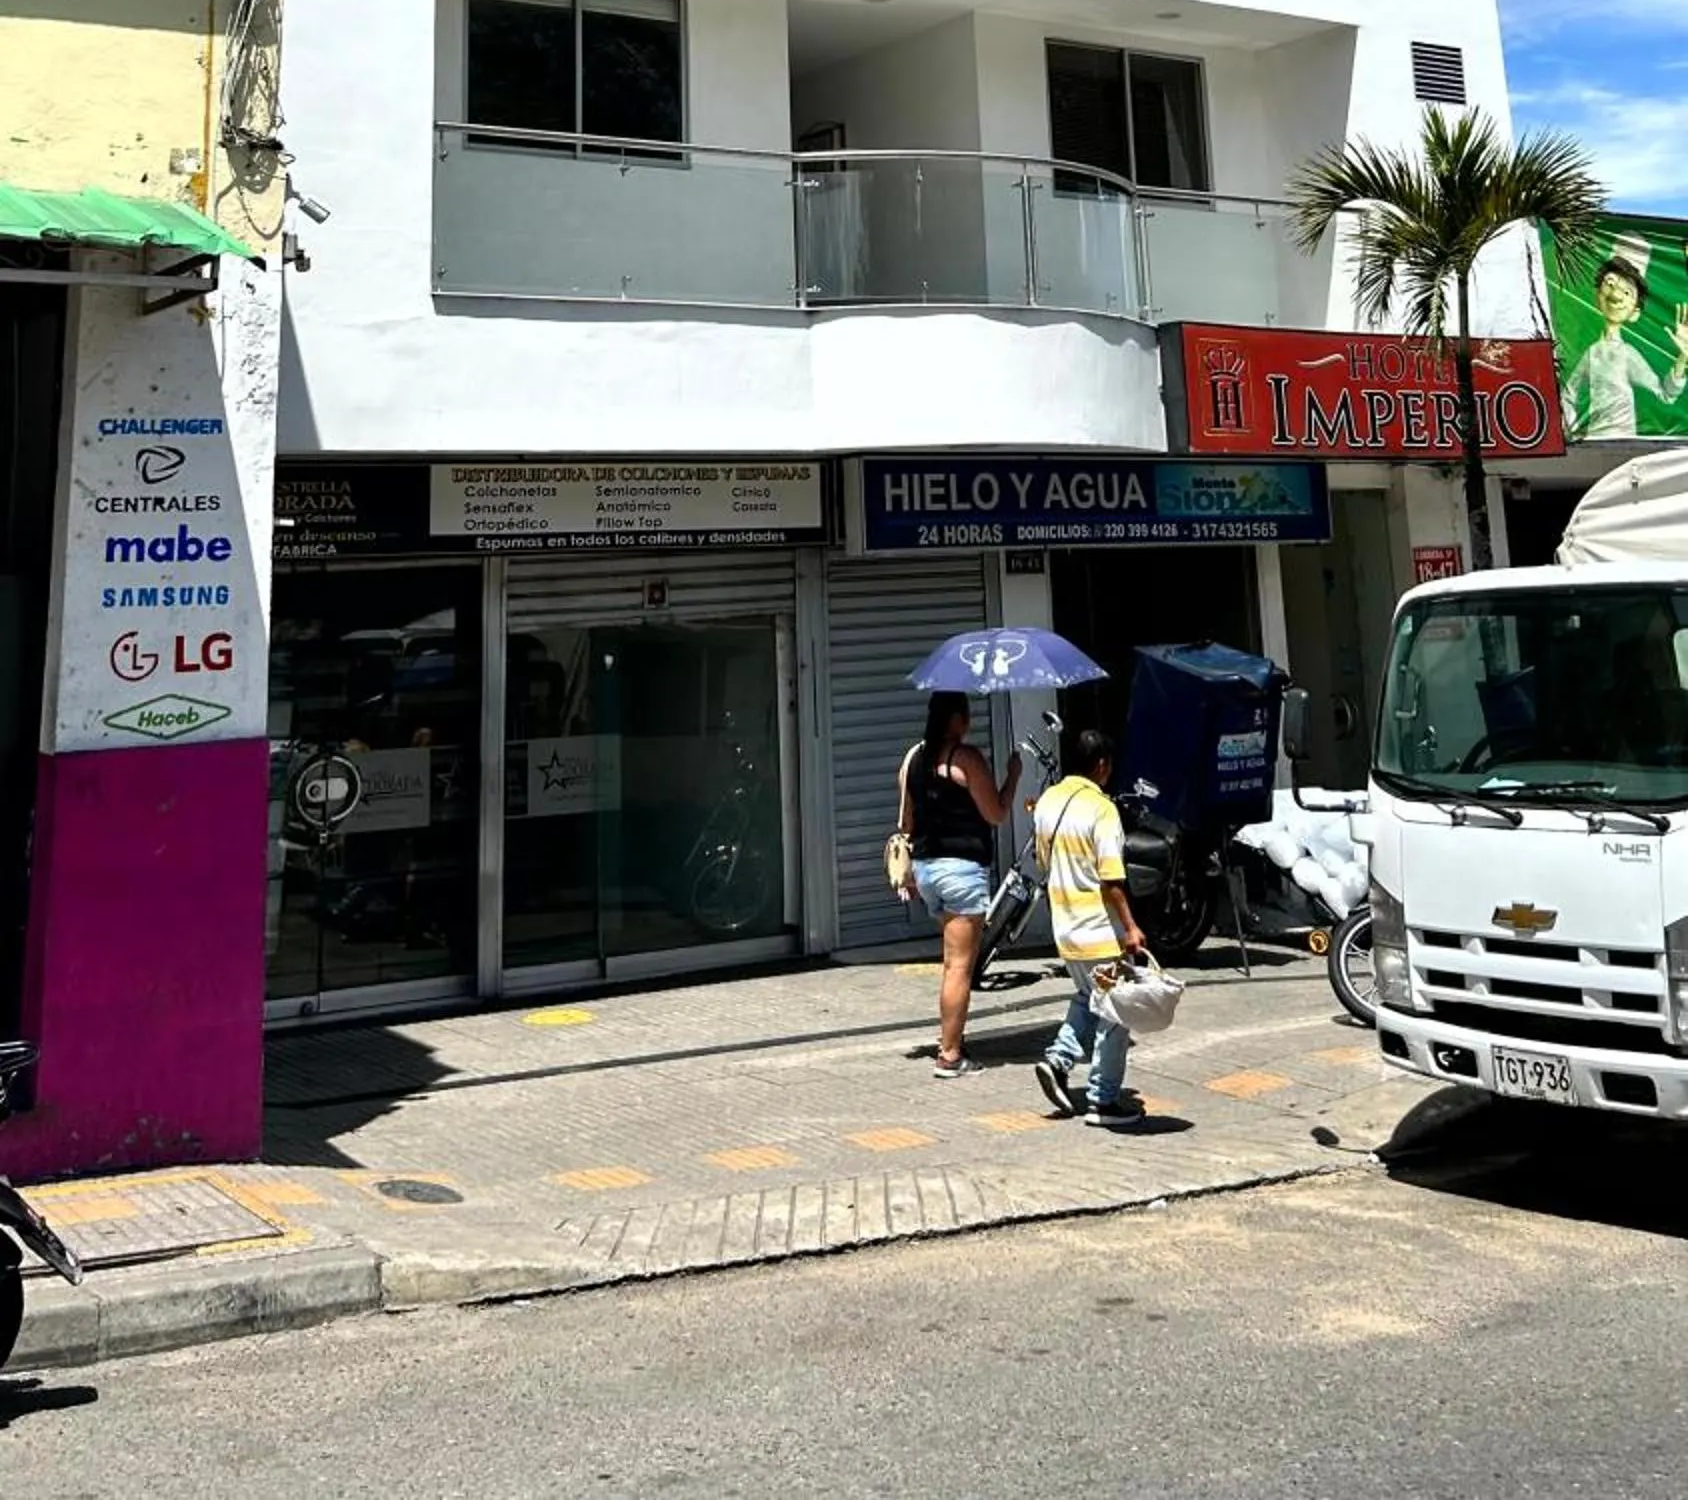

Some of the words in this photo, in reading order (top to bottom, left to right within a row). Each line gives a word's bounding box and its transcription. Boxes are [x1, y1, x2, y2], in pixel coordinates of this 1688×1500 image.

[1346, 343, 1464, 385] HOTE
[1266, 373, 1549, 449] IMPERIO
[99, 418, 223, 436] CHALLENGER
[452, 468, 589, 482] DISTRIBUIDORA
[592, 468, 616, 482] DE
[620, 467, 718, 481] COLCHONES
[721, 467, 732, 481] Y
[736, 466, 810, 480] ESPUMAS
[277, 480, 353, 494] STRELLA
[464, 485, 557, 497] Colchonetas
[884, 473, 1000, 512] HIELO
[1008, 472, 1034, 510] Y
[1043, 471, 1148, 510] AGUA
[95, 496, 221, 513] CENTRALES
[464, 518, 549, 532] Ortopédico
[596, 517, 635, 529] Pillow
[917, 525, 939, 545] 24
[943, 524, 1004, 544] HORAS
[1191, 521, 1279, 538] 3174321565
[105, 524, 232, 563] mabe
[476, 537, 543, 551] Espumas
[547, 538, 567, 548] en
[571, 534, 611, 546] todos
[615, 533, 636, 545] los
[639, 532, 694, 545] calibres
[695, 534, 704, 547] y
[708, 530, 785, 544] densidades
[102, 585, 230, 608] SAMSUNG
[174, 633, 234, 673] LG
[137, 707, 201, 728] Haceb
